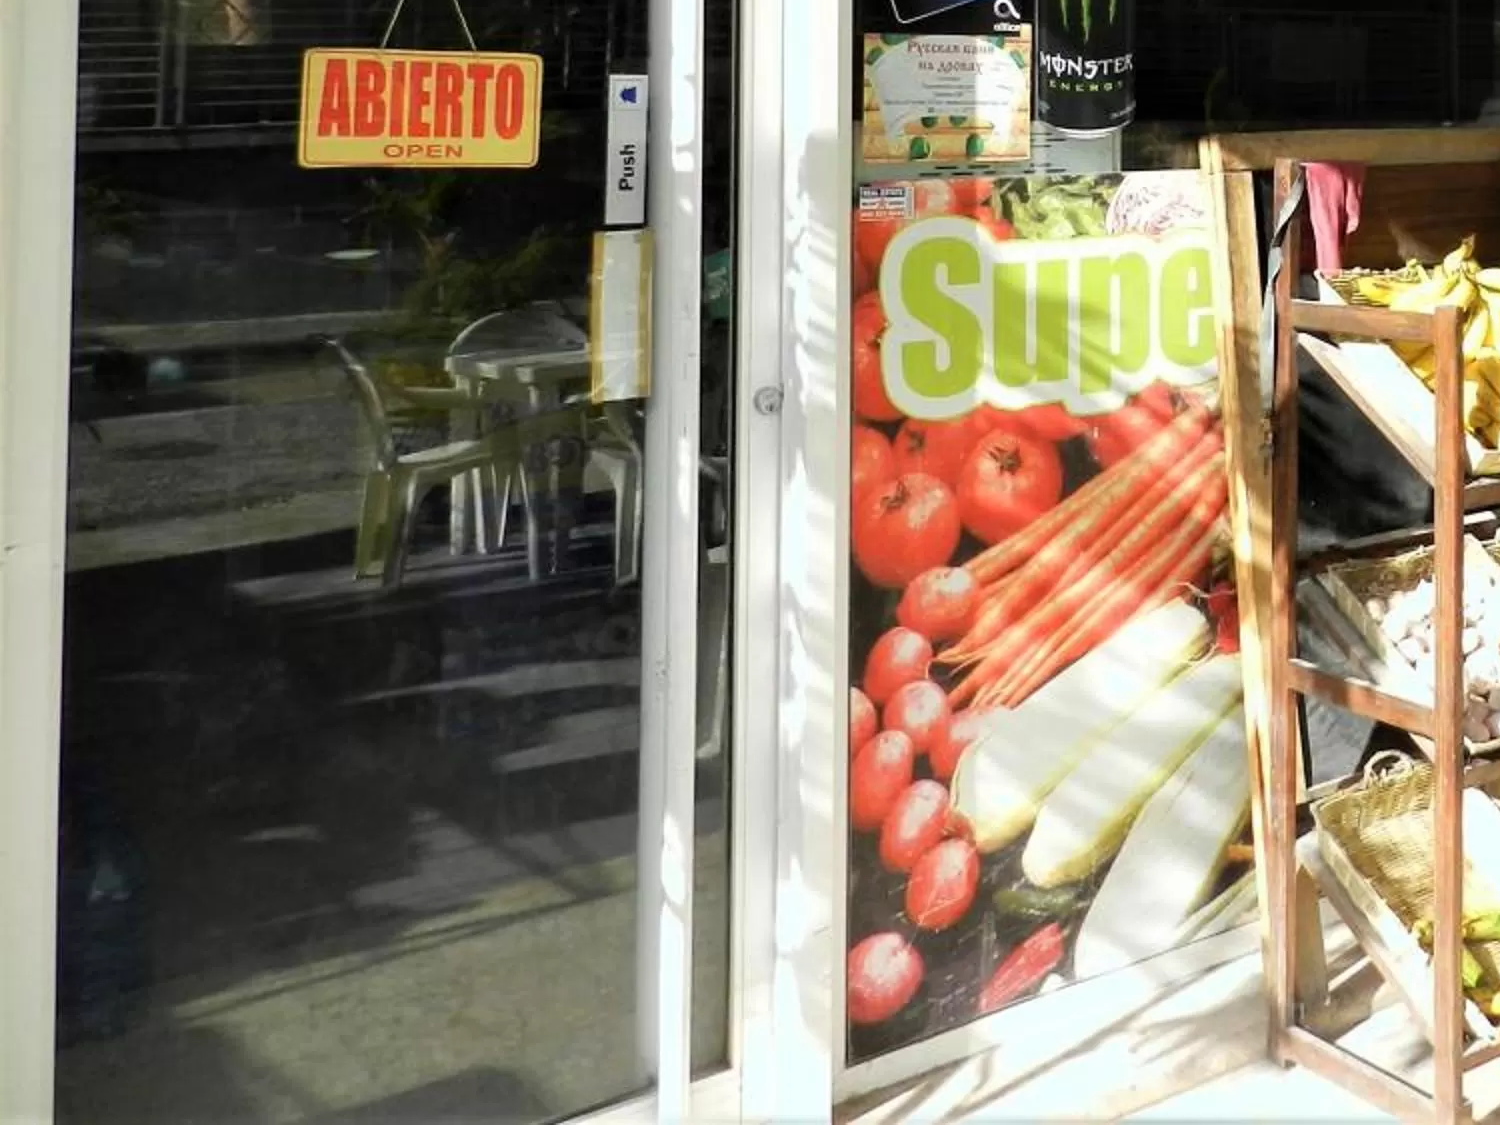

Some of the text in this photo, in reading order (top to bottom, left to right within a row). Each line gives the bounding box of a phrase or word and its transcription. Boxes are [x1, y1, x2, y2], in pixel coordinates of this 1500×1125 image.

[1039, 51, 1134, 81] MONSTER
[316, 58, 525, 140] ABIERTO
[383, 144, 463, 159] OPEN
[618, 143, 636, 192] Push
[880, 217, 1218, 422] Supe
